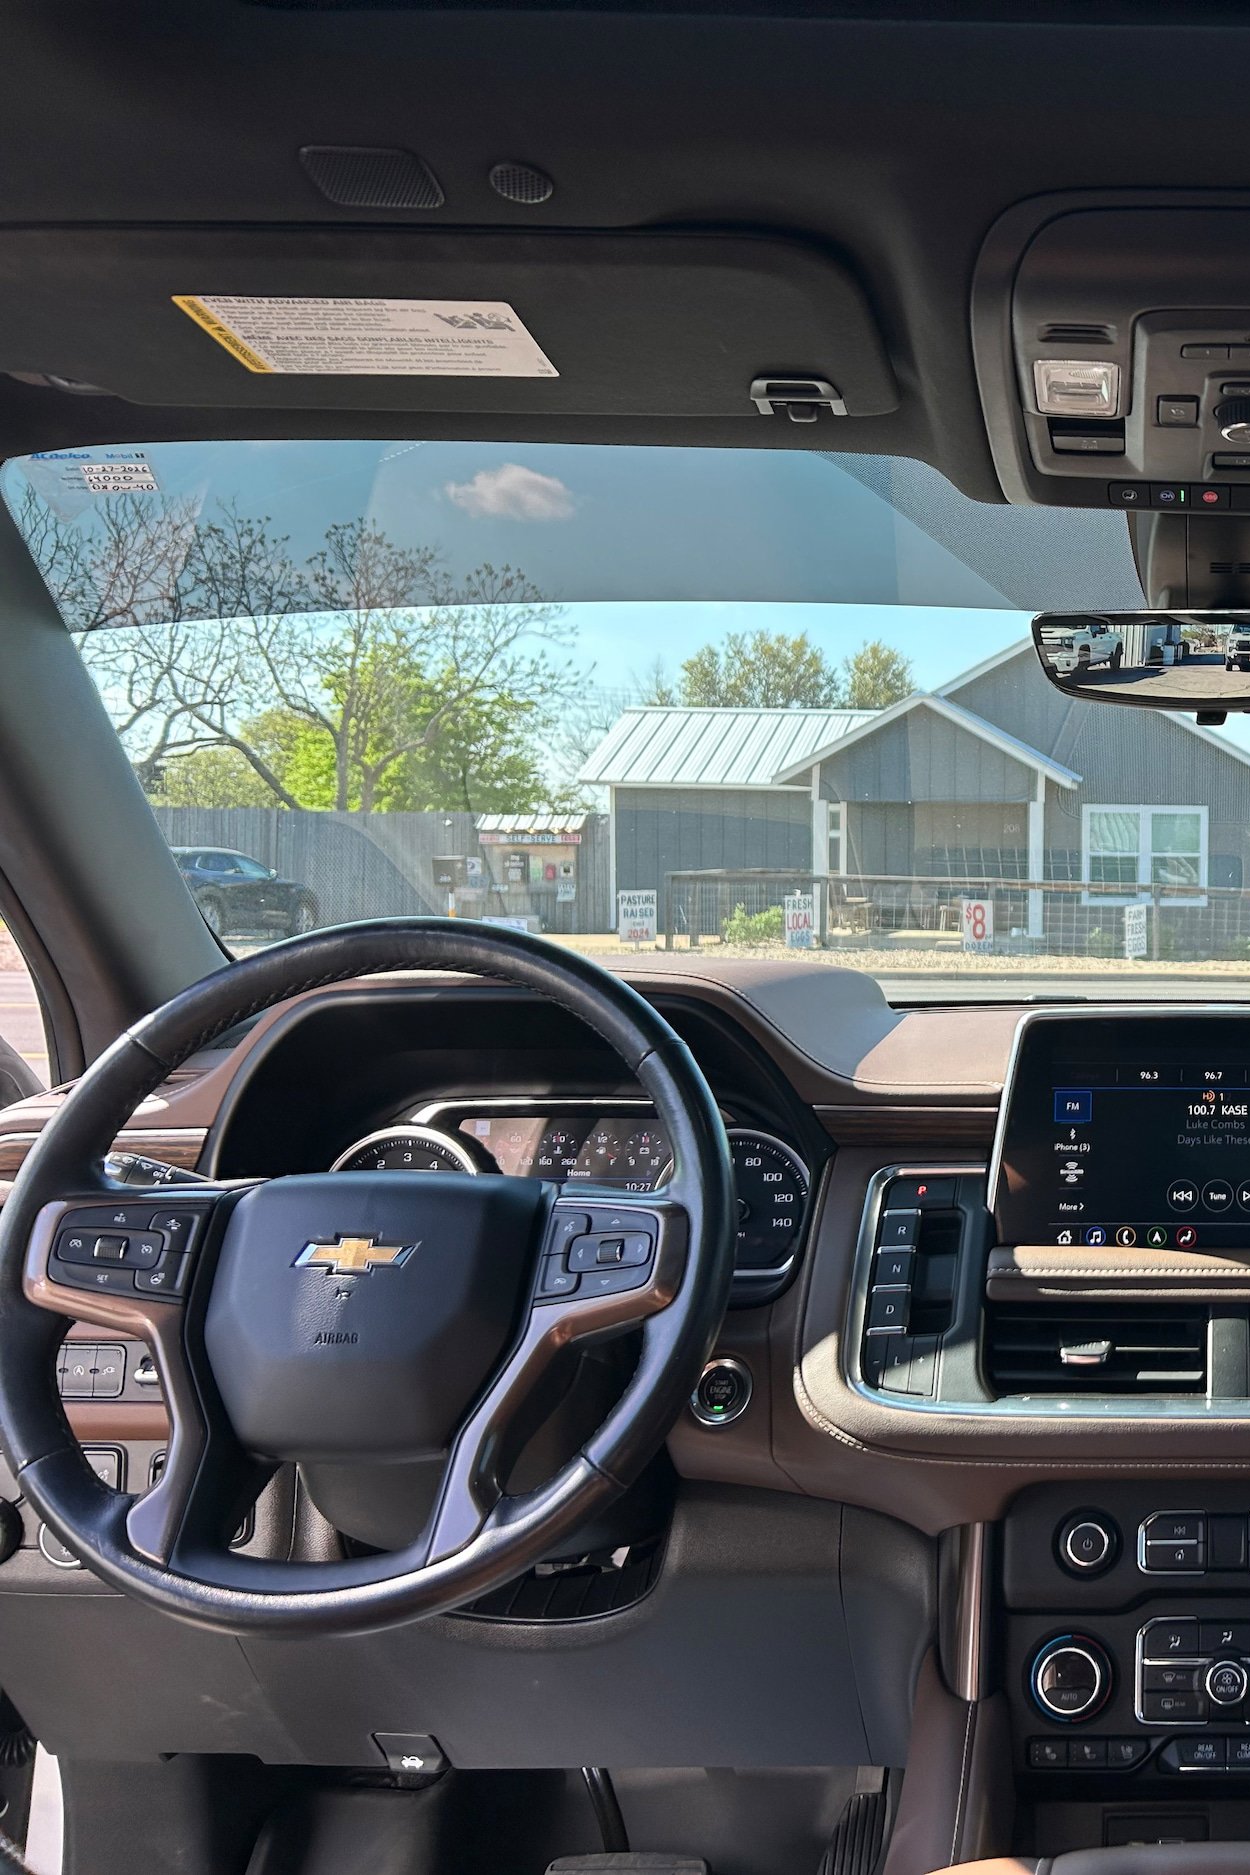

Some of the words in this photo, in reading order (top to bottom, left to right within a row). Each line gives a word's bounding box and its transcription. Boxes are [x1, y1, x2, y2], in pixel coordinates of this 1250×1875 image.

[83, 465, 149, 475] 10-27-2026
[88, 475, 133, 483] 64000
[620, 894, 656, 906] PASTURE
[623, 908, 655, 919] RAISED
[965, 941, 993, 951] DOZEN
[1140, 1071, 1159, 1080] 96.3
[1204, 1071, 1223, 1080] 96.7
[1066, 1102, 1080, 1111] FM
[1187, 1104, 1216, 1116] 100.7
[1221, 1104, 1248, 1116] KASE
[1186, 1119, 1209, 1130] Luke
[1210, 1119, 1246, 1130] Combs
[1177, 1134, 1201, 1147] Days
[1203, 1134, 1223, 1145] Like
[1054, 1143, 1079, 1151] iPhone
[1079, 1143, 1091, 1152] (3)
[403, 1152, 413, 1162] 3
[538, 1158, 553, 1166] 160
[609, 1158, 615, 1166] F
[744, 1157, 762, 1167] 80
[376, 1159, 386, 1170] 2
[429, 1160, 439, 1170] 4
[560, 1158, 577, 1167] 260
[566, 1169, 591, 1177] Home
[762, 1172, 783, 1182] 100
[624, 1182, 652, 1192] 10:27
[917, 1185, 928, 1196] P
[773, 1193, 794, 1203] 120
[1209, 1192, 1227, 1200] Tune
[1058, 1203, 1078, 1211] More
[772, 1217, 793, 1228] 140
[897, 1226, 907, 1235] R
[891, 1264, 902, 1273] N
[885, 1304, 895, 1315] D
[314, 1332, 359, 1345] AIRBAG
[1215, 1684, 1239, 1694] ON/OFF
[1060, 1692, 1078, 1701] AUTO
[1197, 1743, 1214, 1752] REAR
[1193, 1751, 1217, 1760] ON/OFF
